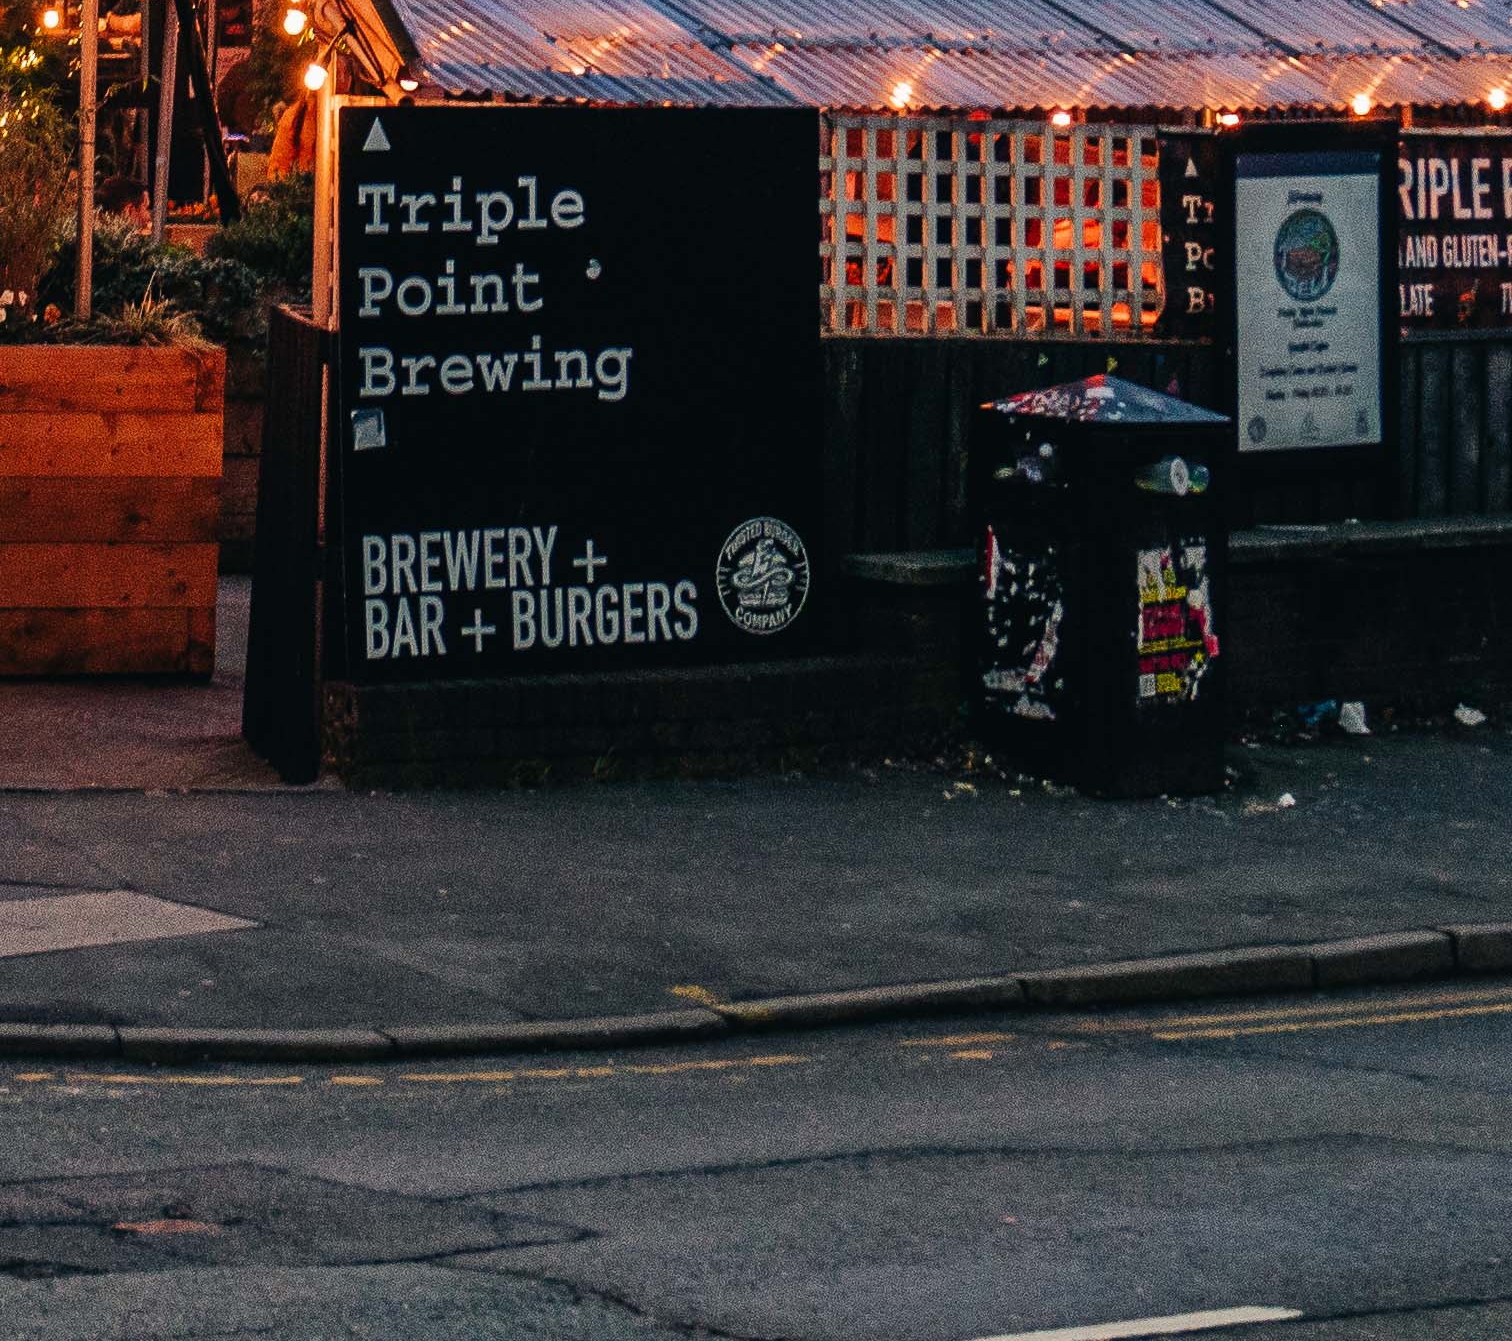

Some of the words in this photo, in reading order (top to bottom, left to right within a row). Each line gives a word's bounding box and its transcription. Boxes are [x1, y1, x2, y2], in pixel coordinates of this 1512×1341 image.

[358, 176, 584, 244] Triple
[1406, 235, 1437, 267] AND
[358, 260, 544, 317] Point
[359, 335, 633, 401] Brewing
[362, 525, 559, 597] BREWERY
[365, 595, 447, 659] BAR
[512, 580, 698, 652] BURGERS
[735, 603, 793, 628] COMPANY
